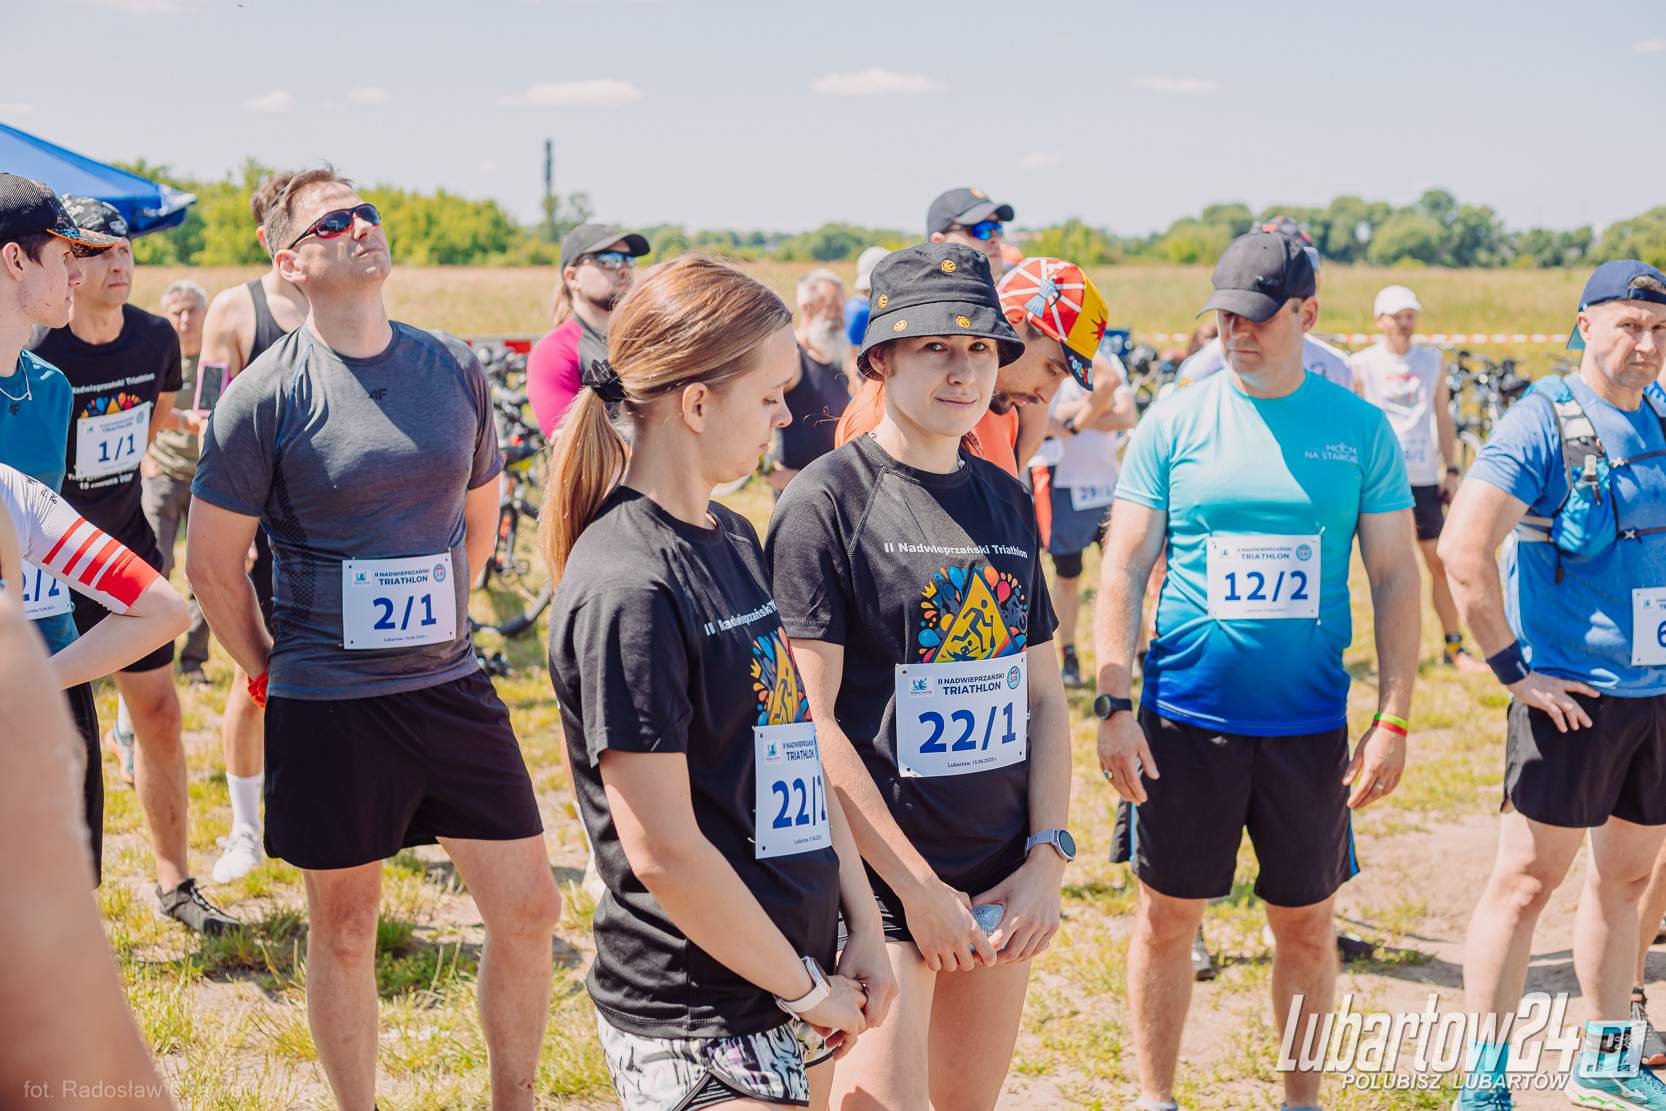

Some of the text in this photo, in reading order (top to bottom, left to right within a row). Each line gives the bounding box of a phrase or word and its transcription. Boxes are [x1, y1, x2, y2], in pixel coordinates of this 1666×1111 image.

[98, 434, 135, 462] 1/1
[884, 542, 1028, 559] II Nadwieprzański Triathlon
[379, 575, 428, 586] TRIATHLON
[1224, 570, 1308, 602] 12/2
[372, 593, 437, 631] 2/1
[944, 672, 1005, 685] NADWIEPRZAŃSKI
[943, 682, 1001, 696] TRIATHLON
[918, 702, 1017, 754] 22/1
[786, 749, 815, 761] TRIATHLON
